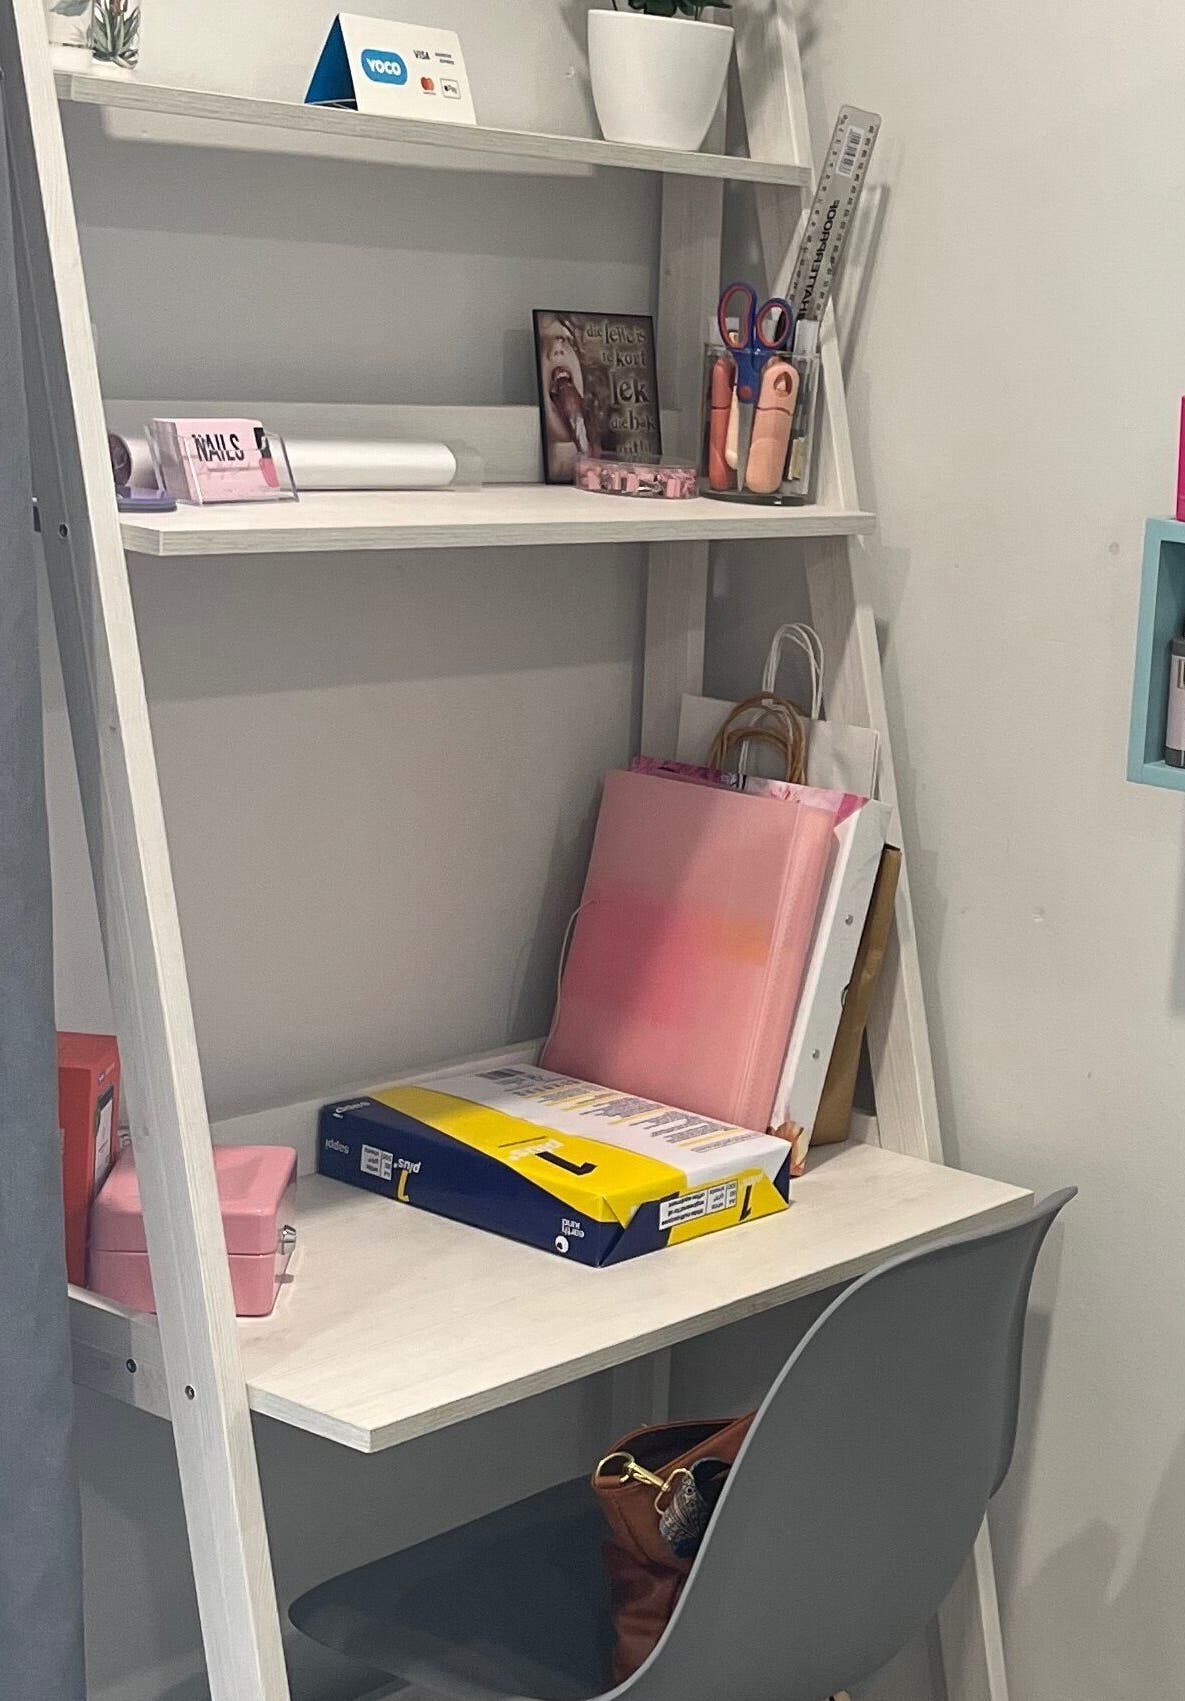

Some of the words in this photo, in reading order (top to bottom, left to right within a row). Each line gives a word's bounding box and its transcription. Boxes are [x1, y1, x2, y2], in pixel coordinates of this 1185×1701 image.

[413, 49, 430, 60] VISA
[366, 57, 402, 76] YOCO
[611, 373, 650, 405] lek
[191, 433, 245, 462] NAILS
[398, 1158, 421, 1175] plus
